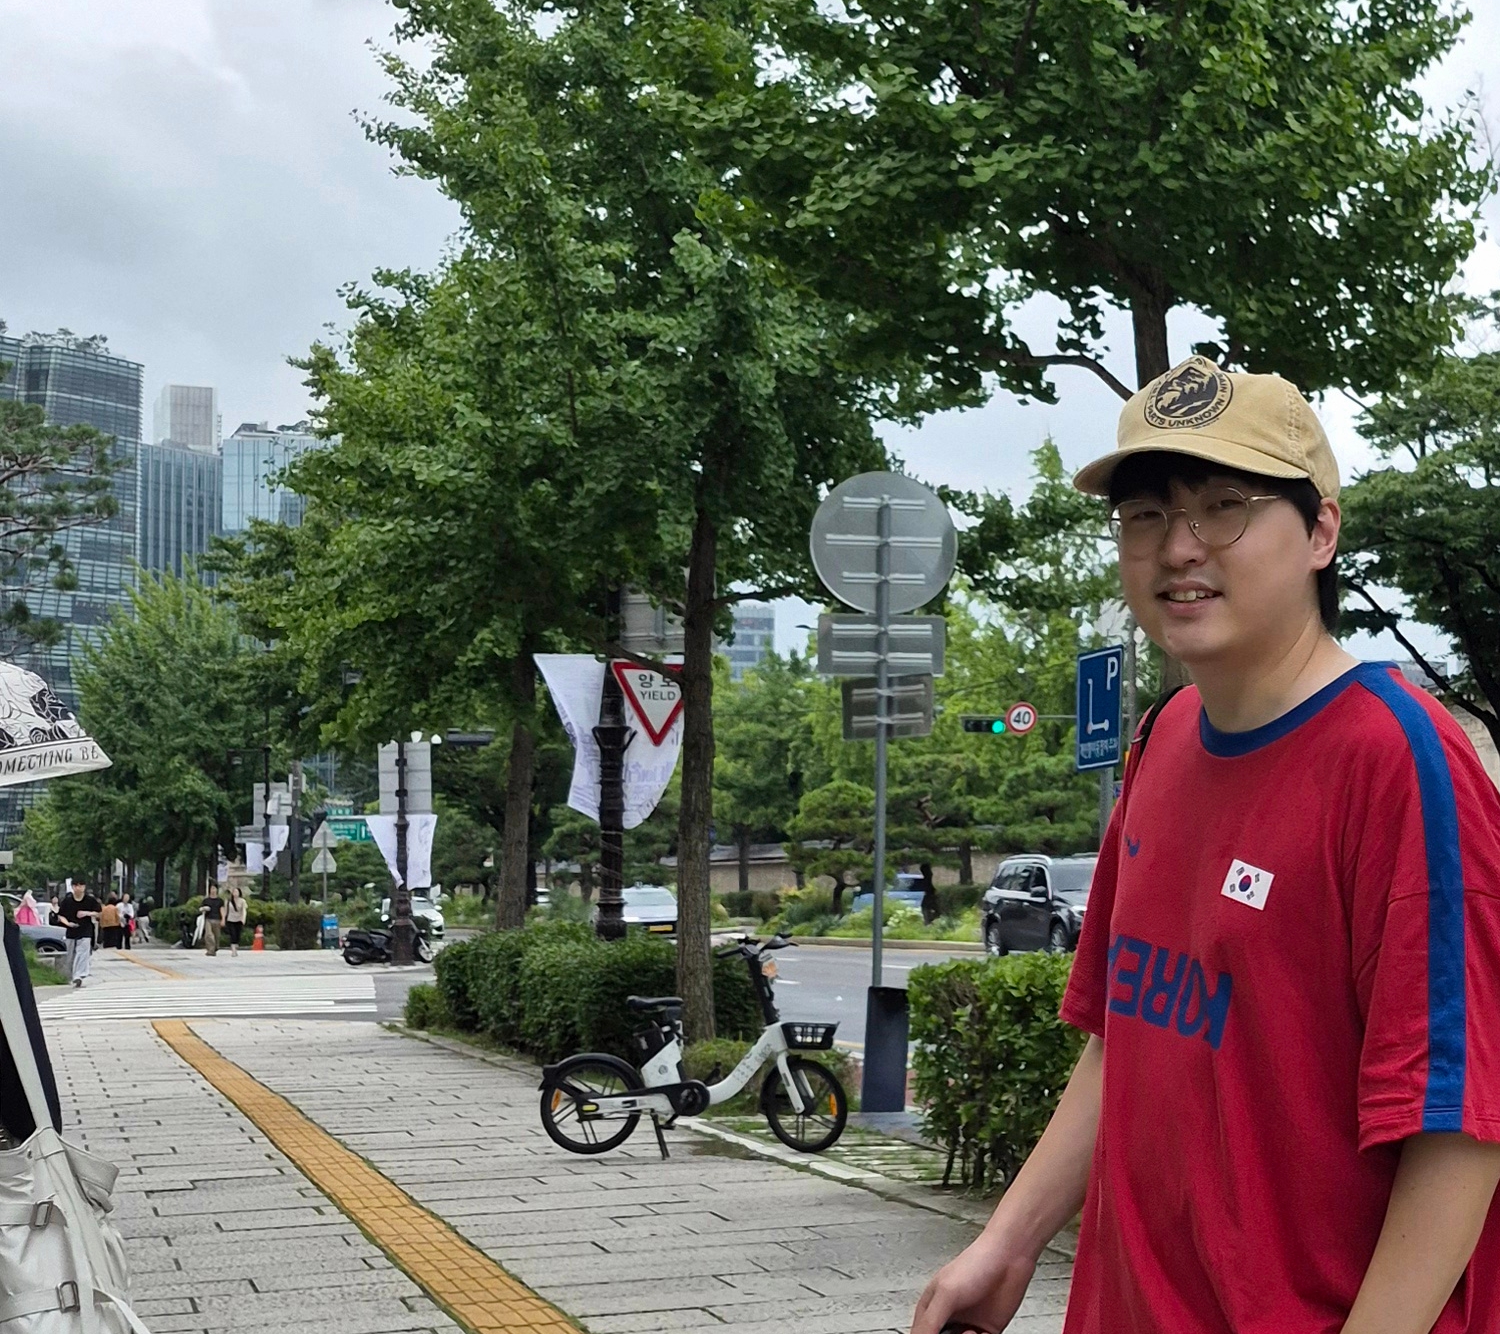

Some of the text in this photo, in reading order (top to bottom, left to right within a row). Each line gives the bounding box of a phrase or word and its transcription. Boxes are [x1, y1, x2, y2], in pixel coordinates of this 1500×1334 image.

[1147, 405, 1166, 425] PARTS
[1168, 398, 1225, 427] UNKNOWN
[1106, 656, 1119, 691] P
[640, 690, 676, 701] YIELD
[1013, 710, 1032, 725] 40
[0, 745, 99, 776] METHING BE
